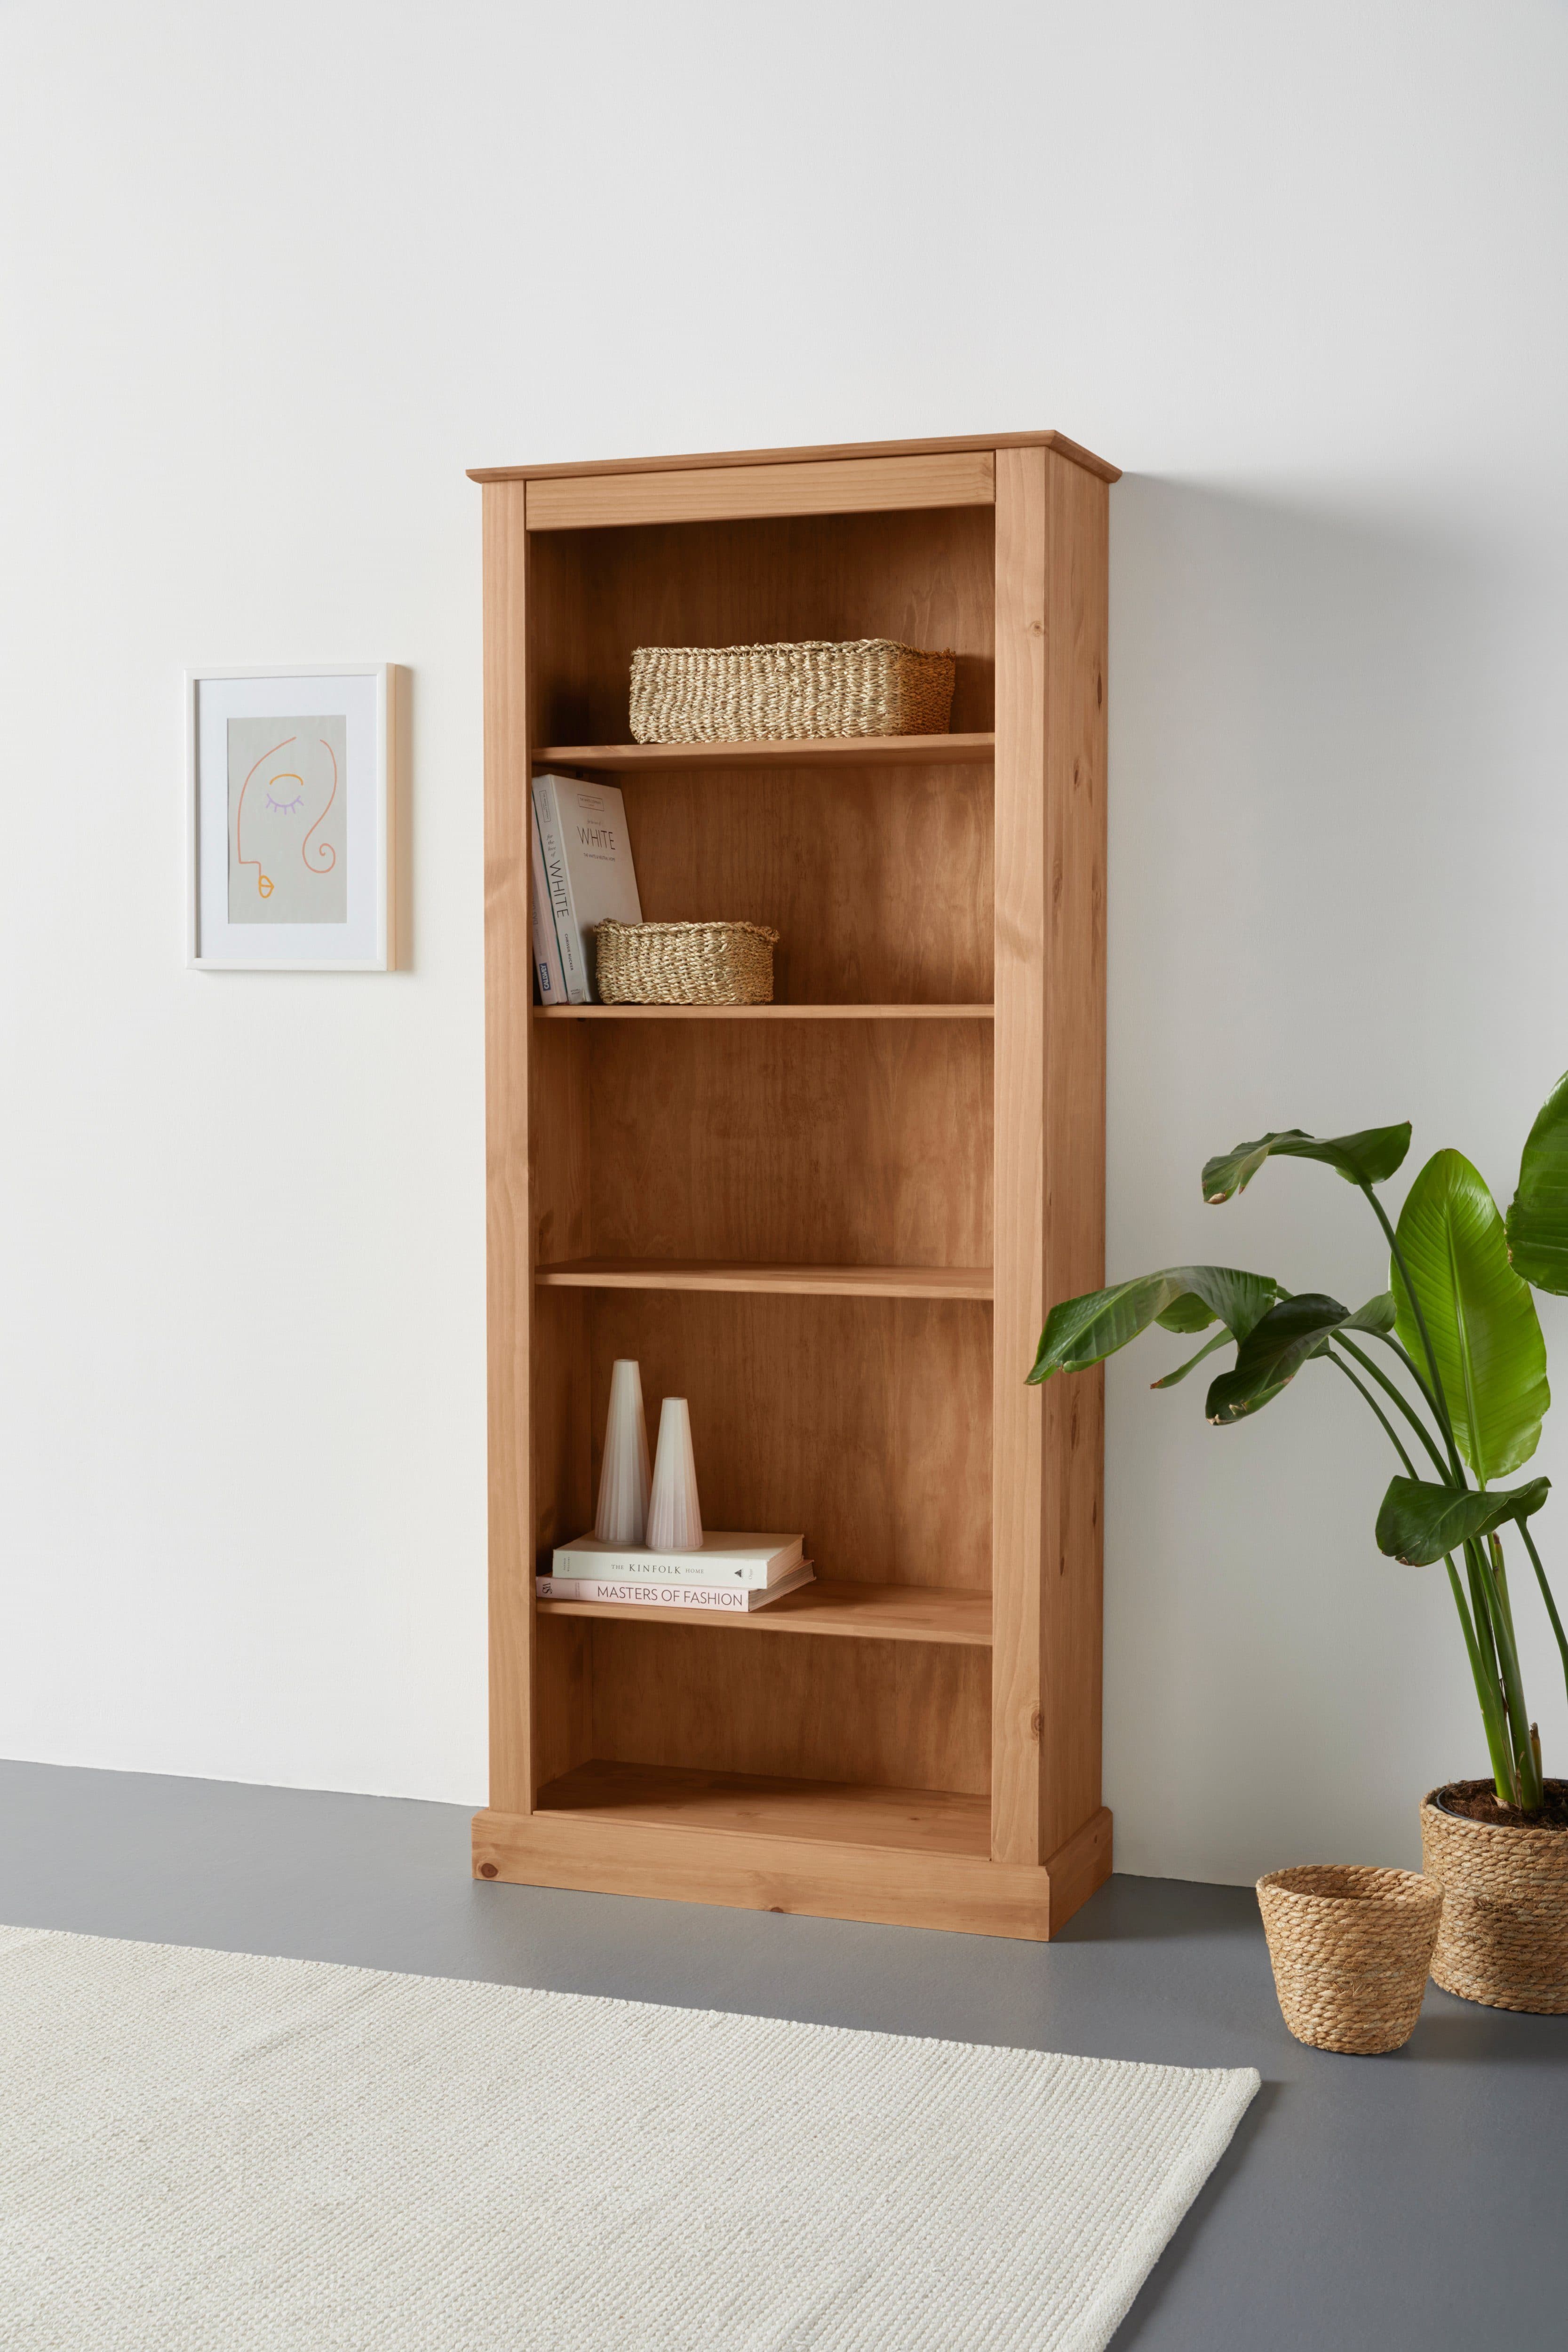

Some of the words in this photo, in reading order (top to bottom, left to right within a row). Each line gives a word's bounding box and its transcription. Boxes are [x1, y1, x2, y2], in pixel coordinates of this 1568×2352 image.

[576, 826, 616, 850] WHITE
[549, 859, 569, 918] WHITE
[541, 964, 549, 990] CALLWEY
[629, 1564, 681, 1574] KINFOLK
[597, 1585, 658, 1601] MASTERS
[661, 1589, 680, 1602] OF
[684, 1590, 742, 1606] FASHION
